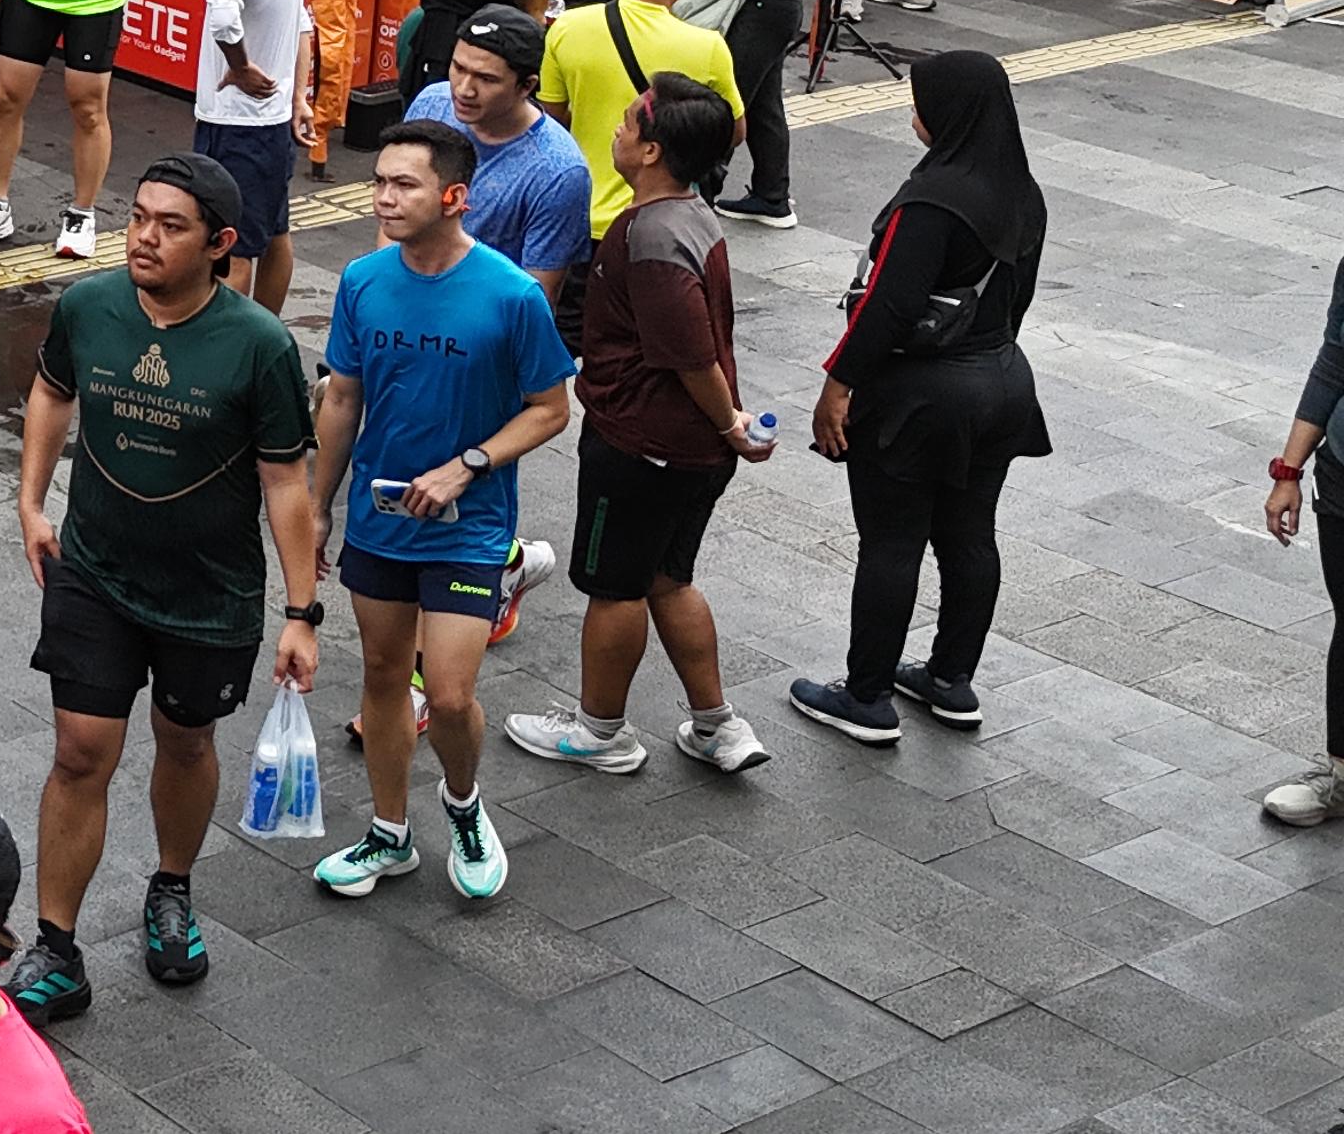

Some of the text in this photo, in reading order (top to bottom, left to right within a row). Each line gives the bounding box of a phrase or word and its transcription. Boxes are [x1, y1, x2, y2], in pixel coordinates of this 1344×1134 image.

[152, 45, 187, 64] Gadget
[89, 381, 212, 419] MANGKUNEGARAN
[113, 400, 181, 431] RUN 2025
